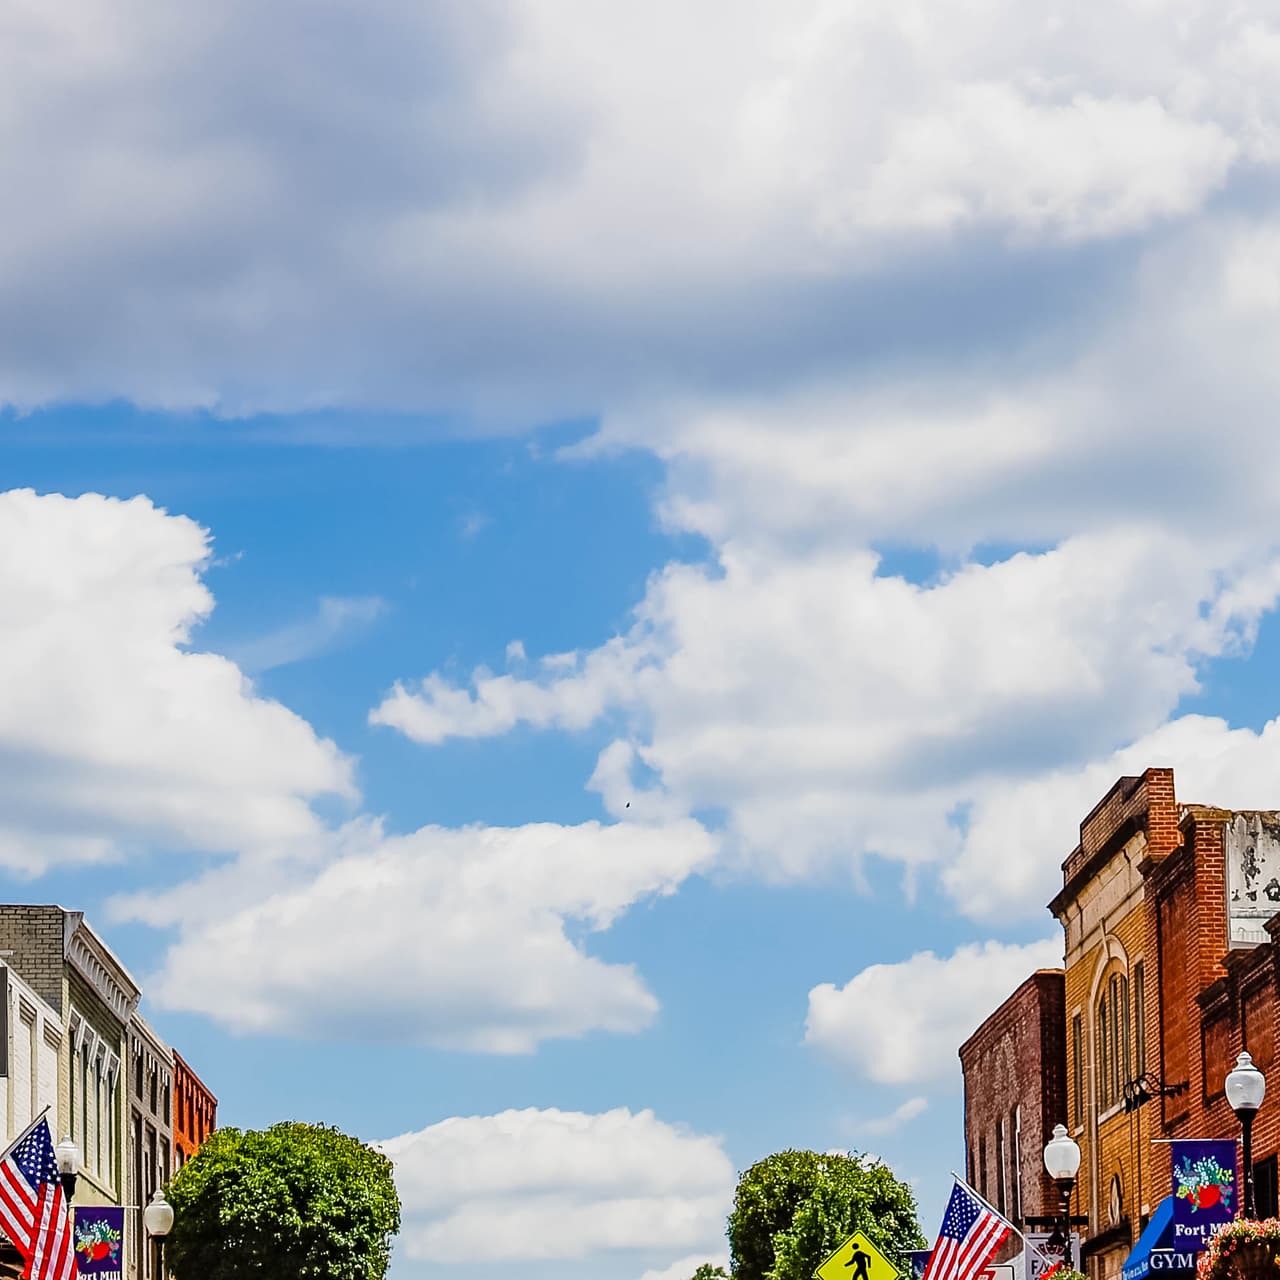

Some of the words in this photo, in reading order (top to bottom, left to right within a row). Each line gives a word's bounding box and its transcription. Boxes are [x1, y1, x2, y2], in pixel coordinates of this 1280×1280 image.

[1175, 1223, 1206, 1236] Fort
[1150, 1253, 1194, 1270] GYM
[79, 1271, 97, 1280] ort
[100, 1270, 121, 1280] Mill
